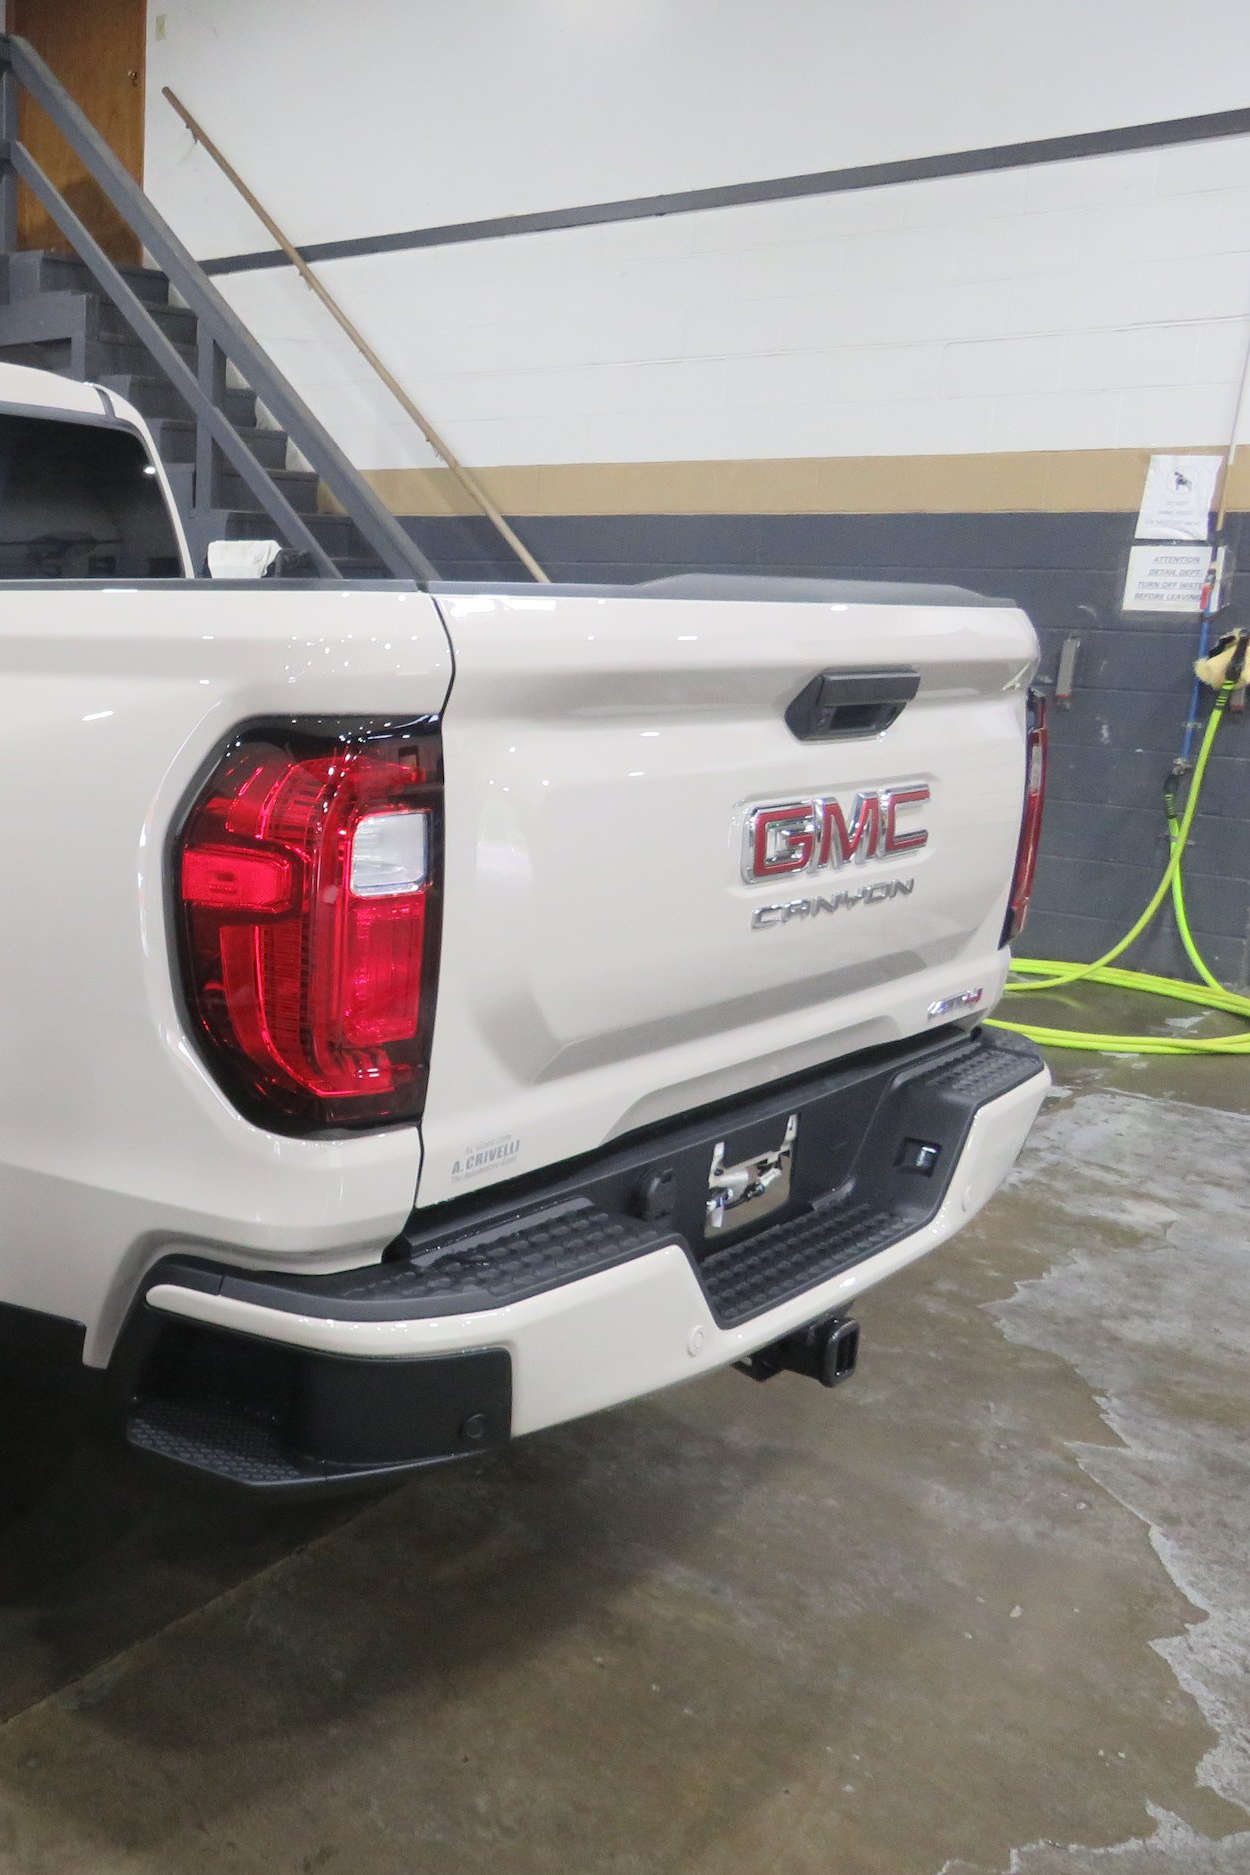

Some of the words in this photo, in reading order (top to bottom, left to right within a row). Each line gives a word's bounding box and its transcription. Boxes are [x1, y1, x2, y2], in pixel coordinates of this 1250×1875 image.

[1152, 556, 1201, 564] ATTENTION
[1137, 581, 1159, 589] TURN
[1161, 581, 1177, 589] OFF
[1179, 582, 1206, 590] WATE
[1134, 593, 1165, 601] BEFORE
[740, 783, 931, 886] GMC
[751, 877, 915, 931] CANYON
[452, 1160, 464, 1175] A.
[465, 1139, 520, 1170] CRIVELLI
